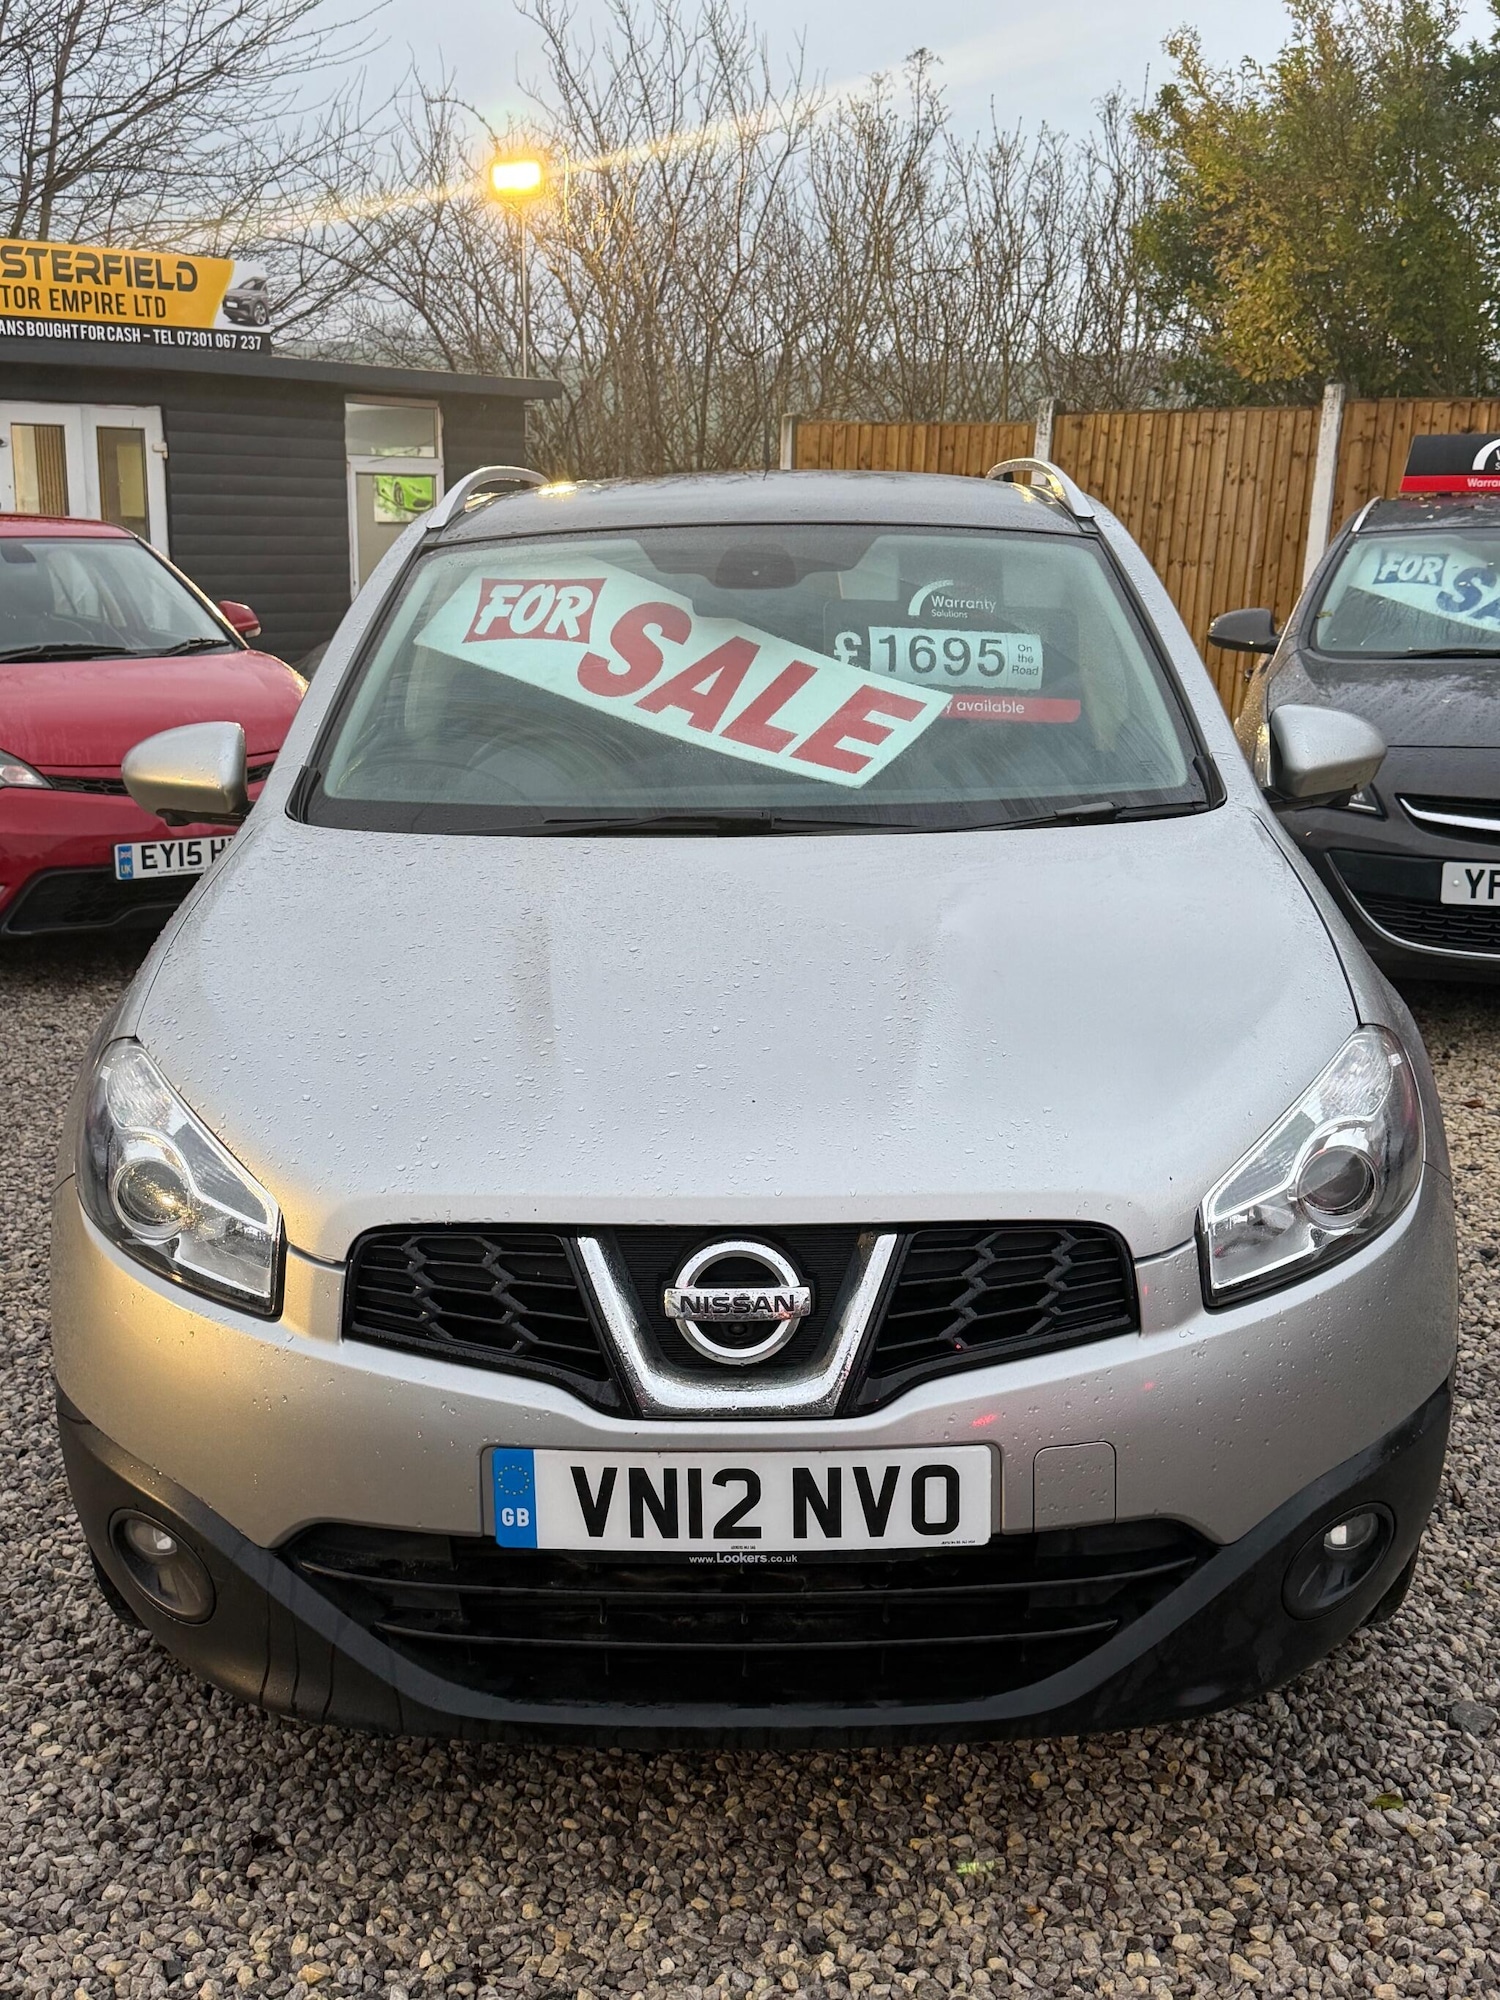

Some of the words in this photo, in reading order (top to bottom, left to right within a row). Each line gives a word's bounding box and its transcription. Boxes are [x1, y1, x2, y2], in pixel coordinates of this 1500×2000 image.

[1, 245, 198, 293] STERFIELD
[0, 284, 41, 311] TOR
[49, 288, 127, 316] EMPIRE
[134, 294, 167, 319] LTD
[26, 320, 79, 340] BOUGHT
[80, 324, 106, 341] FOR
[106, 325, 141, 344] CASH
[152, 328, 176, 345] TEL
[177, 330, 213, 348] 07301
[215, 333, 237, 349] 067
[240, 335, 262, 351] 237
[1467, 477, 1500, 488] Warra
[1378, 553, 1443, 584] FOR
[931, 595, 997, 614] Warranty
[931, 608, 968, 619] Solutions
[1017, 644, 1033, 653] On
[1017, 653, 1035, 664] the
[475, 582, 588, 639] FOR
[577, 601, 928, 774] SALE
[1011, 664, 1039, 676] Road
[956, 699, 1025, 715] available
[141, 841, 202, 870] EY15
[210, 837, 232, 864] H
[680, 1294, 795, 1314] NISSAN
[570, 1466, 762, 1539] VN12
[792, 1464, 961, 1539] NVO
[501, 1508, 530, 1527] GB
[688, 1551, 798, 1564] www.Lookers.co.uk
